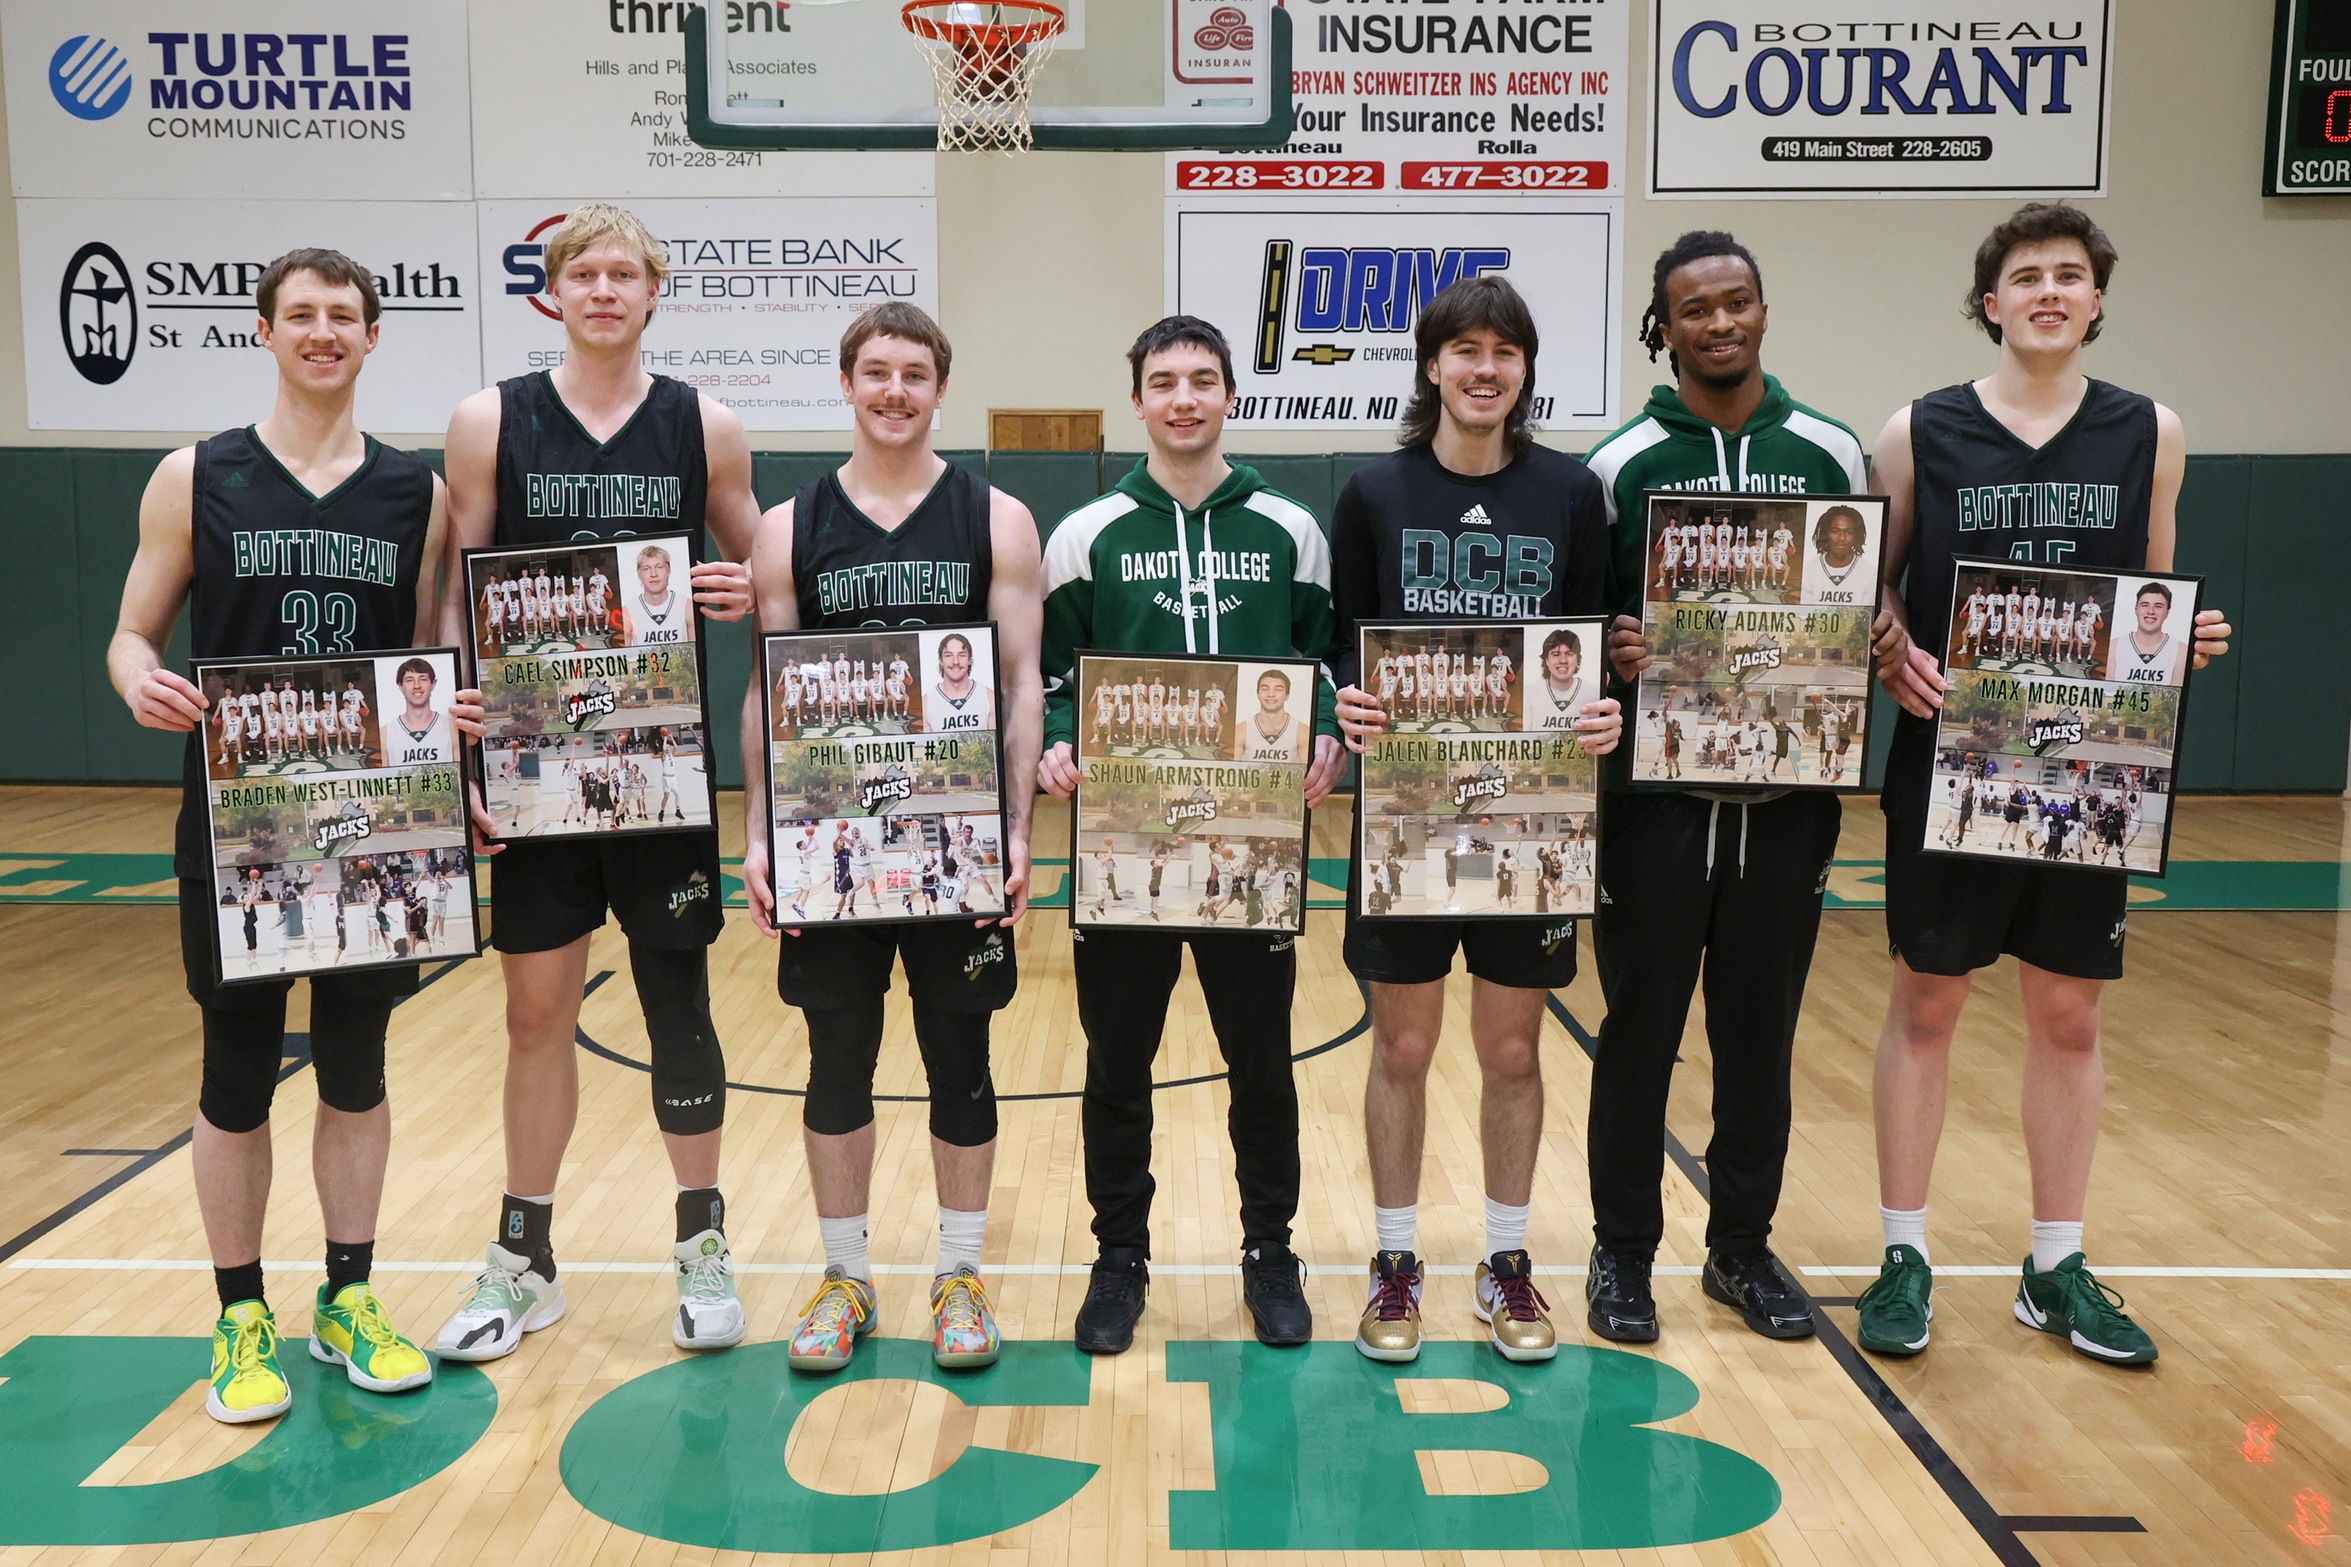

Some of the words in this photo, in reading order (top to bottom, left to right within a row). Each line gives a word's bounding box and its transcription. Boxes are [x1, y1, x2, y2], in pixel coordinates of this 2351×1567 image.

[609, 0, 791, 33] thrient
[1217, 16, 1239, 24] Auto
[1203, 34, 1221, 43] Life
[1318, 15, 1592, 53] INSURANCE
[1754, 22, 2082, 42] BOTTINEAU
[148, 33, 410, 76] TURTLE
[1188, 59, 1252, 67] INSURAN
[586, 60, 619, 75] Hills
[628, 60, 658, 75] and
[1672, 21, 2087, 118] COURANT
[150, 79, 411, 111] MOUNTAIN
[1292, 71, 1345, 95] BRYAN
[1353, 71, 1462, 96] SCHWEITZER
[1470, 72, 1497, 96] INS
[1506, 71, 1572, 95] AGENCY
[1581, 71, 1609, 95] INC
[147, 118, 406, 140] COMMUNICATIONS
[631, 112, 672, 128] Andy
[1361, 103, 1496, 132] Insurance
[1511, 103, 1604, 132] Needs!
[653, 132, 693, 147] Mike
[1478, 140, 1537, 154] Rolla
[1772, 142, 1799, 158] 419
[1804, 142, 1842, 158] Main
[1846, 142, 1894, 158] Street
[1902, 140, 1982, 158] 228-2605
[647, 152, 762, 167] 701-228-2471
[782, 238, 904, 265] BANK
[702, 275, 915, 298] BOTTINEAU
[656, 303, 732, 313] TRENGTH
[754, 303, 829, 313] STABILITY
[149, 324, 182, 348] St
[689, 350, 754, 366] AREA
[761, 349, 831, 365] SINCE
[687, 374, 771, 387] 228-2204
[1366, 397, 1398, 420] ND
[527, 473, 681, 519] BOTTINEAU
[1957, 482, 2119, 532] BOTTINEAU
[1460, 514, 1492, 525] adidas
[233, 529, 398, 587] BOTTINEAU
[1121, 550, 1182, 582] DAKOT
[1401, 528, 1554, 598] DCB
[817, 561, 970, 615] BOTTINEAU
[1818, 590, 1853, 603] JACKS
[1153, 590, 1243, 619] BASETALL
[1403, 588, 1546, 618] BASKETBALL
[1676, 609, 1728, 631] RICKY
[1735, 611, 1796, 633] ADAMS
[1805, 613, 1840, 634] #30
[643, 629, 678, 643] JACKS
[504, 662, 544, 685] CAEL
[552, 655, 628, 681] SIMPSON
[637, 652, 671, 674] #32
[1728, 648, 1780, 676] JACKS
[2127, 668, 2164, 682] JACKS
[1981, 677, 2020, 701] MAX
[2028, 682, 2104, 709] MORGAN
[2113, 689, 2150, 712] #45
[566, 692, 615, 724] JACKS
[942, 714, 979, 730] JACKS
[2028, 722, 2083, 748] JACKS
[402, 748, 438, 763] JACKS
[809, 746, 847, 767] PHIL
[855, 742, 916, 764] GIBAUT
[925, 740, 959, 761] #20
[1253, 749, 1288, 760] JACKS
[1373, 741, 1428, 762] JALEN
[1437, 739, 1543, 761] BLANCHARD
[1090, 764, 1147, 785] SHAUN
[1154, 765, 1260, 789] ARMSTRONG
[1269, 771, 1293, 789] #4
[220, 784, 287, 808] BRADEN
[293, 776, 413, 801] WEST-LINNETT
[421, 773, 452, 793] #33
[860, 778, 911, 809] JACKS
[1454, 777, 1506, 806] JACKS
[1165, 801, 1216, 827] JACKS
[314, 815, 371, 850] JACKS
[669, 882, 709, 911] JACKS
[964, 945, 1004, 973] JACKS
